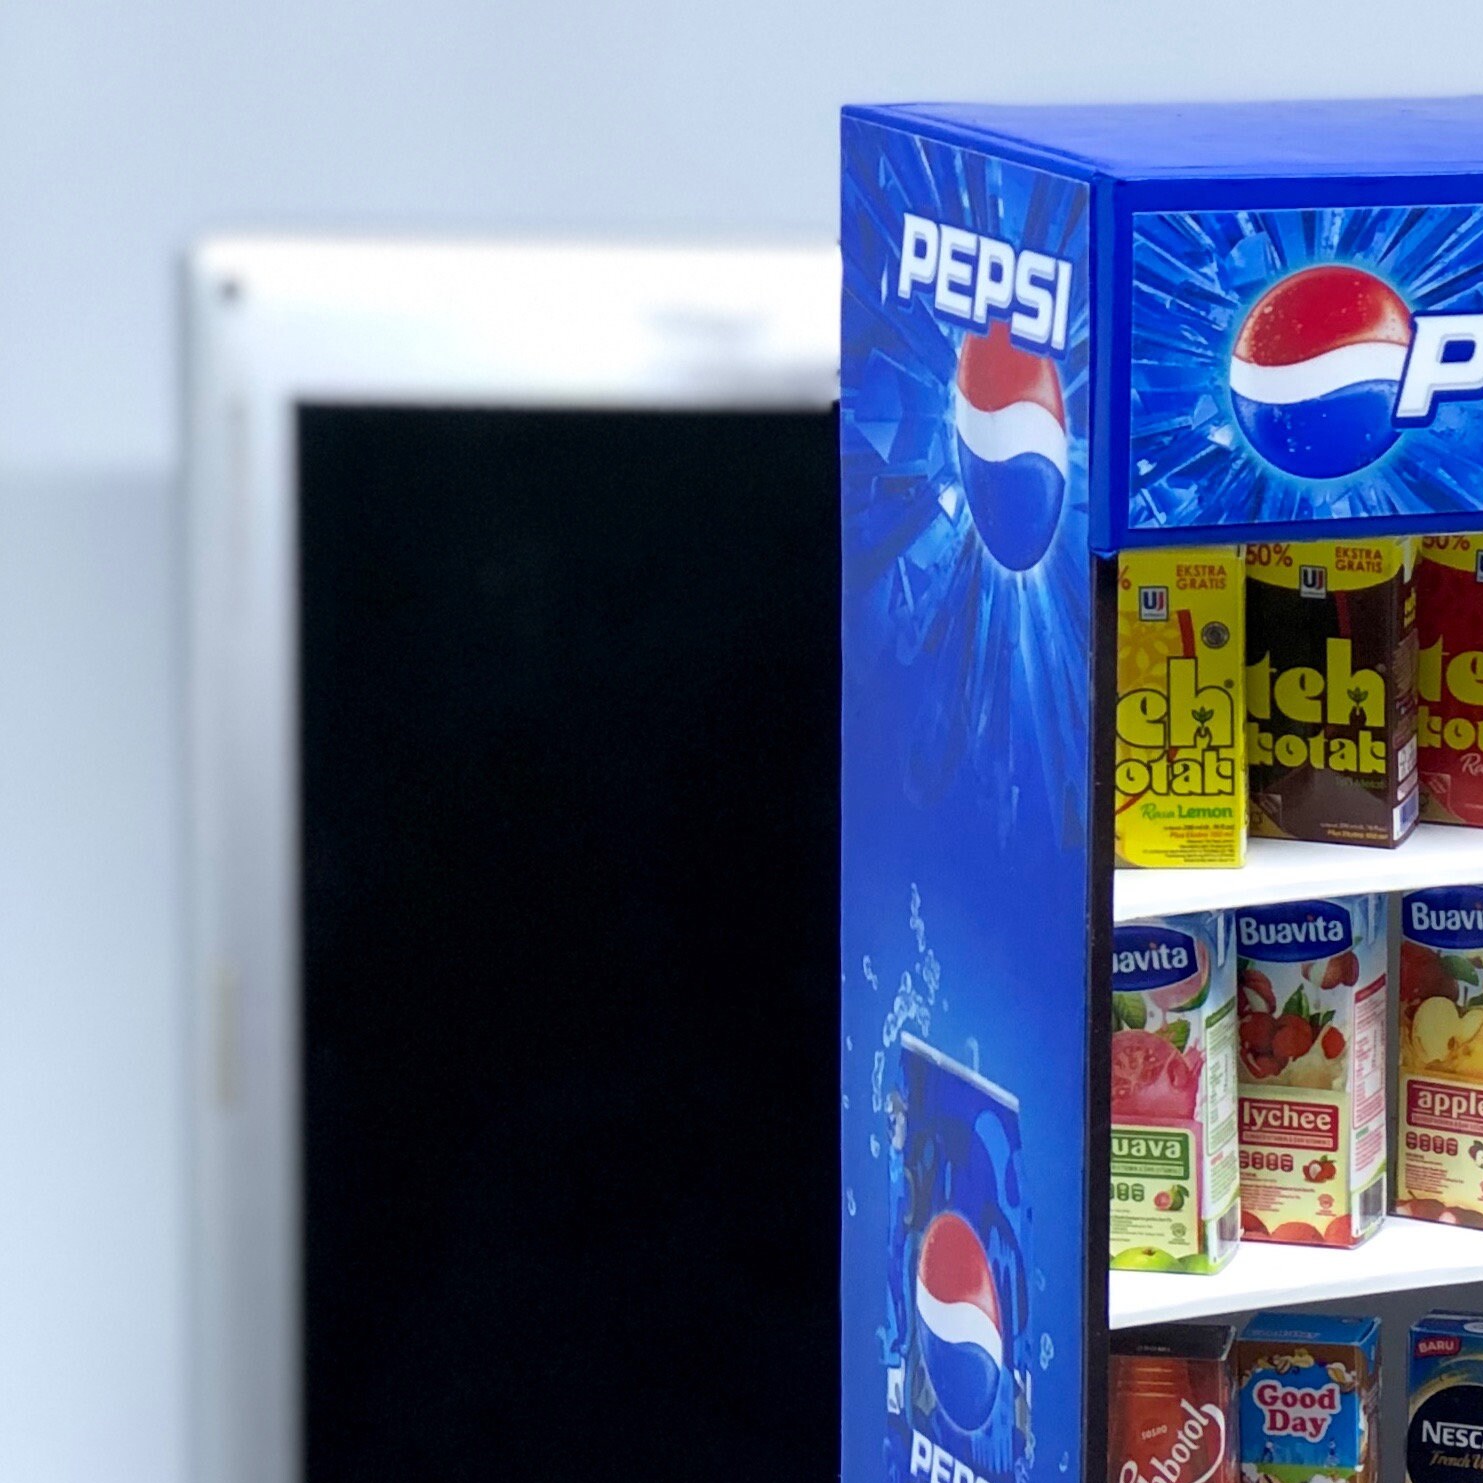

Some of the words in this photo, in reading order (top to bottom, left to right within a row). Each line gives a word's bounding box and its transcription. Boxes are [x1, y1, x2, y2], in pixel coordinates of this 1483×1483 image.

[898, 211, 1074, 346] PEPSI
[1245, 543, 1293, 567] 50%
[1335, 546, 1382, 560] EKSTRA
[1336, 559, 1383, 573] GRATIS
[1175, 564, 1227, 578] EKSTRA
[1176, 579, 1227, 591] GRATIS
[1246, 637, 1386, 728] teh
[1115, 656, 1234, 749] eh
[1249, 720, 1387, 775] kotak
[1115, 749, 1235, 796] otak
[1177, 804, 1233, 819] Lemon
[1239, 914, 1345, 947] Buavita
[1113, 941, 1189, 975] avita
[1243, 1104, 1333, 1131] lychee
[1112, 1138, 1182, 1159] uava
[1418, 1339, 1455, 1353] BARU
[1256, 1383, 1337, 1411] Good
[1267, 1410, 1327, 1439] Day
